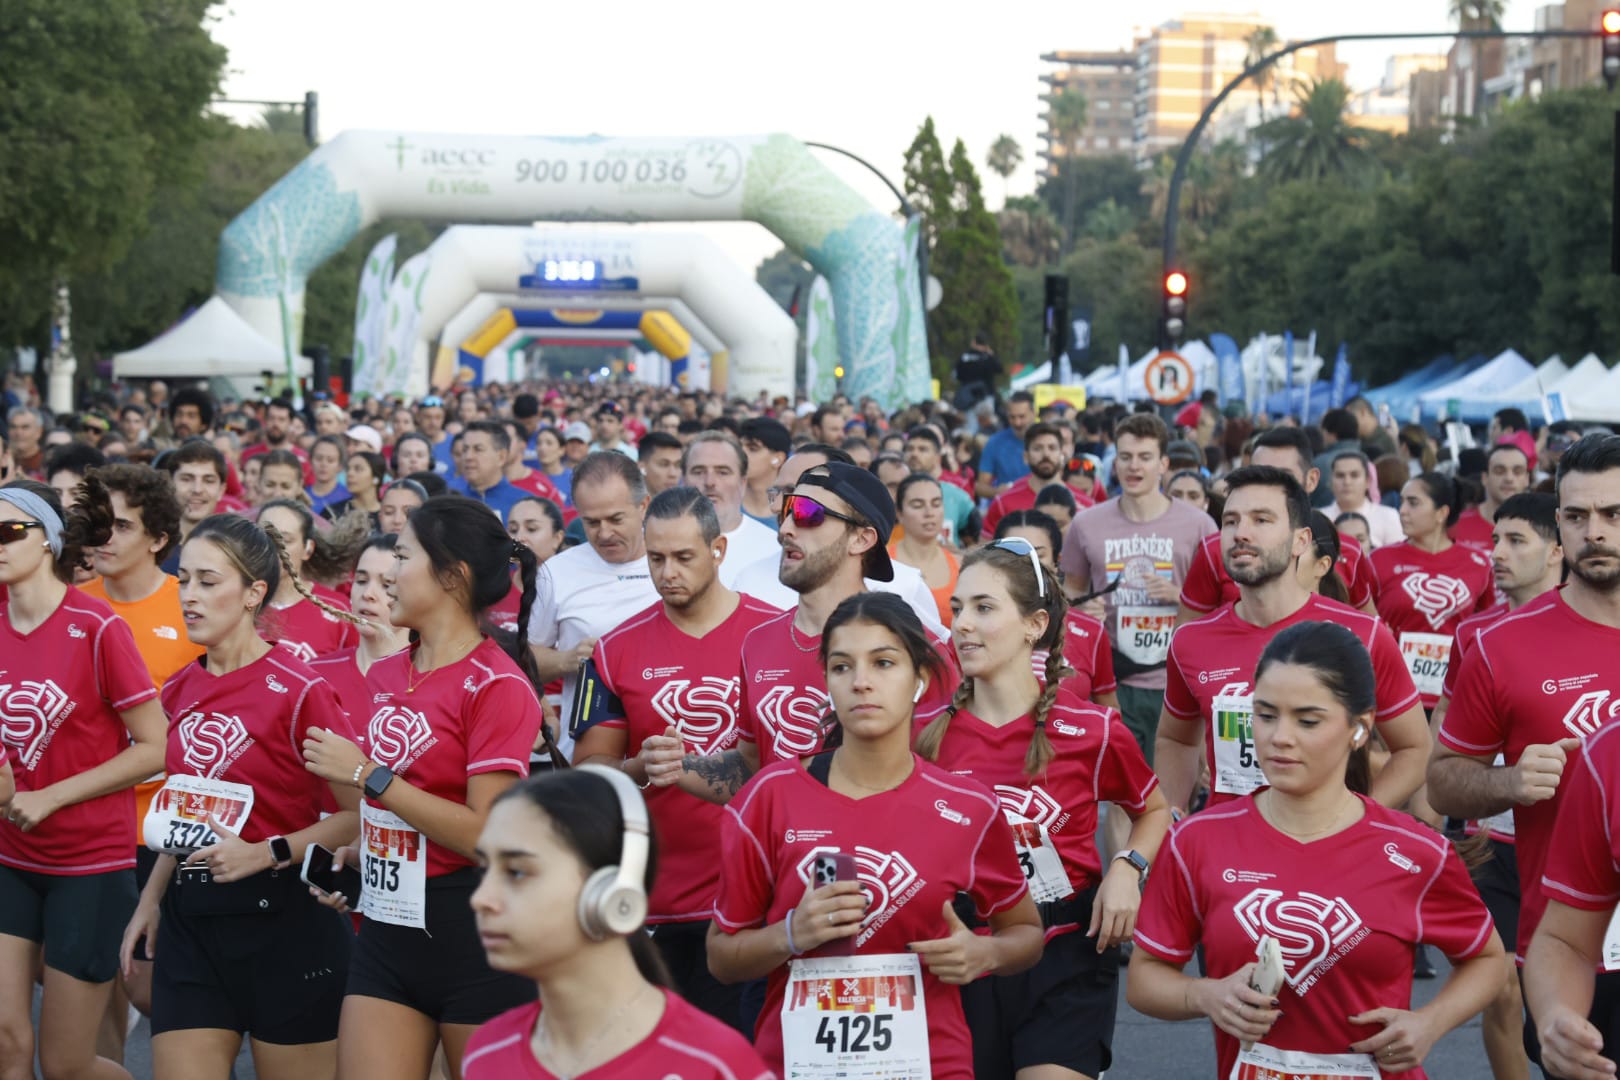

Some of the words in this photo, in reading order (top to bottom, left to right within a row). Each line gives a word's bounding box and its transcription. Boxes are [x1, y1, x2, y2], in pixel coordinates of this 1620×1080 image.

[421, 148, 496, 167] aecc
[515, 159, 569, 183] 900
[577, 160, 628, 183] 100
[635, 160, 687, 183] 036
[1104, 533, 1174, 562] PYRÉNÉES
[1134, 631, 1169, 648] 5041
[1412, 658, 1449, 678] 5027
[53, 701, 78, 730] SOLIDARIA
[1240, 743, 1260, 768] 5
[163, 820, 217, 849] 3324
[364, 854, 400, 891] 3513
[873, 906, 898, 932] PERSONA
[897, 879, 927, 907] SOLIDARIA
[1315, 953, 1341, 983] PERSONA
[1339, 926, 1372, 956] SOLIDARIA
[815, 1014, 893, 1053] 4125
